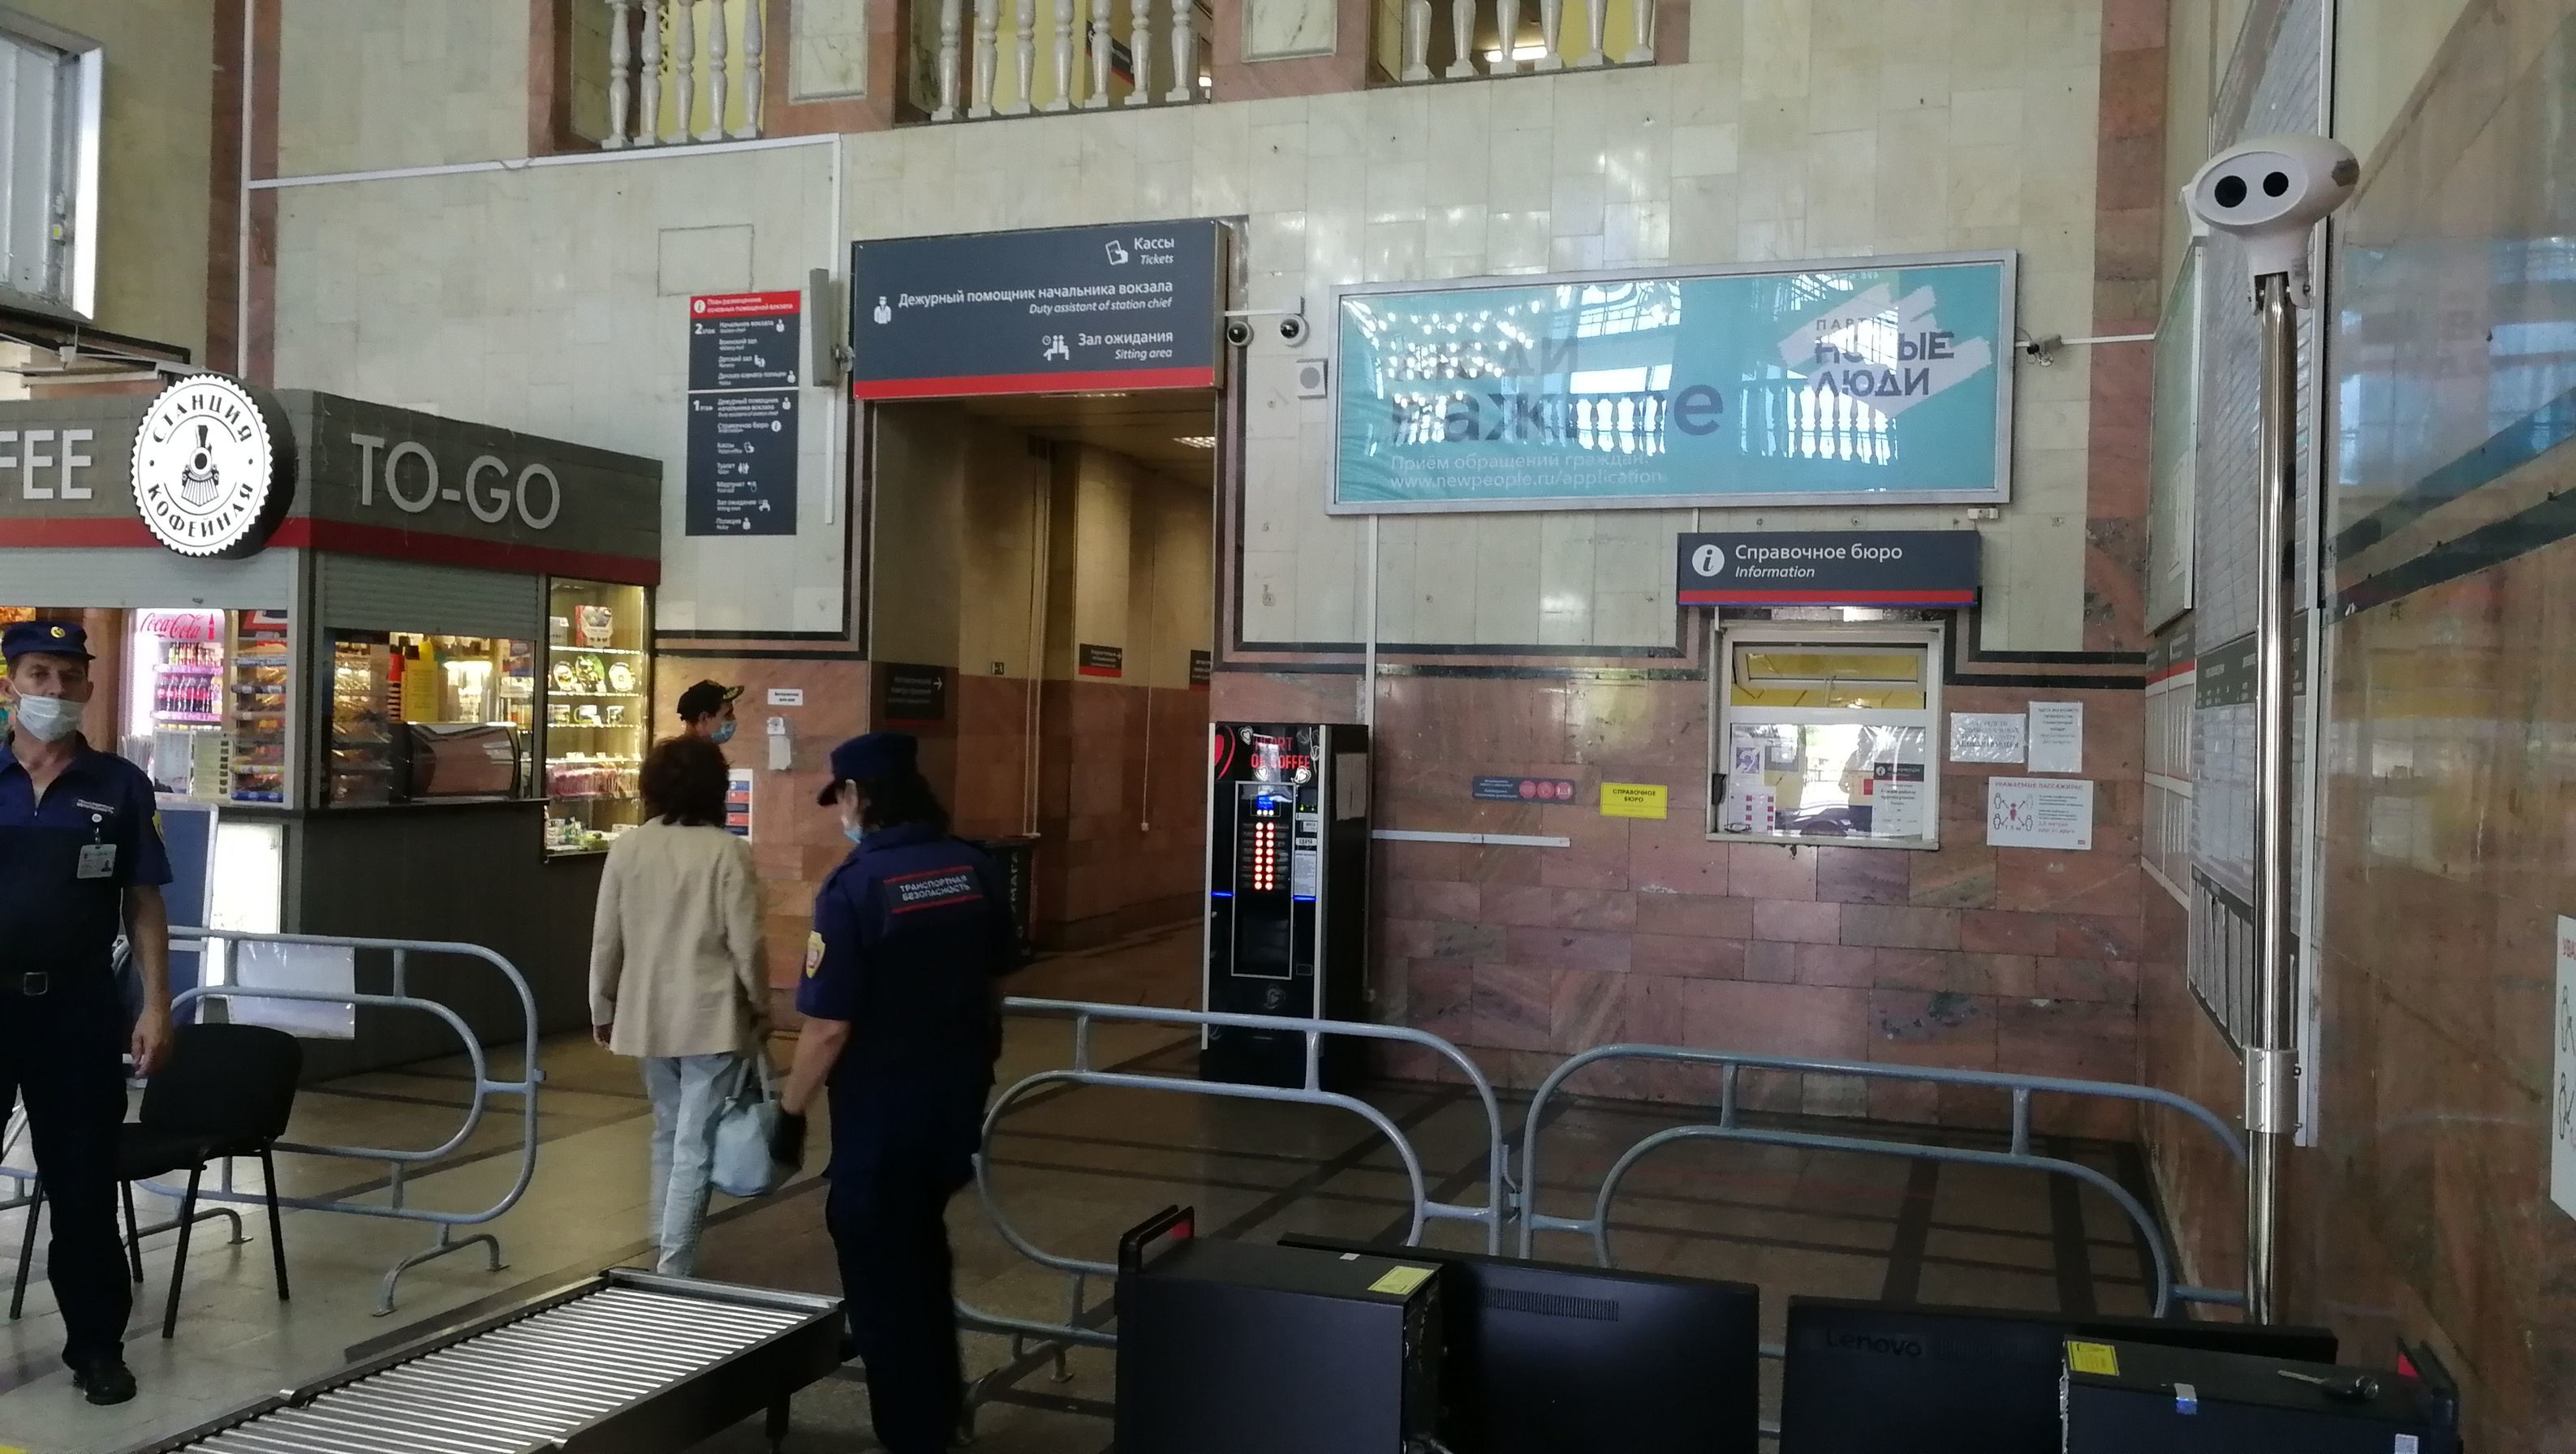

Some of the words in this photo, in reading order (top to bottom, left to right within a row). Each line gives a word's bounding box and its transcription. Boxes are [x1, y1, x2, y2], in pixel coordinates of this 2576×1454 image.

[1134, 237, 1175, 250] Кассы
[1140, 253, 1174, 265] Tickets
[898, 290, 964, 308] Дежурный
[967, 288, 1036, 304] помощник
[1038, 285, 1117, 299] начальника
[1119, 282, 1173, 294] вокзала
[1029, 303, 1053, 316] Duty
[1054, 302, 1097, 314] assistant
[1098, 299, 1111, 311] of
[1111, 299, 1146, 310] station
[1148, 297, 1173, 309] chief
[695, 323, 703, 334] 2
[1078, 333, 1102, 346] Зал
[1105, 332, 1173, 346] ожидания
[1815, 331, 1954, 364] НЫЕ
[1115, 348, 1148, 361] Sitting
[1148, 349, 1173, 359] area
[1816, 367, 1930, 398] ЛЮДИ
[693, 400, 700, 411] 1
[1392, 383, 1723, 443] аже
[153, 394, 252, 444] СТАНЦИЯ
[1391, 455, 1450, 473] Приём
[1454, 452, 1559, 471] обращений
[351, 432, 561, 529] TO-GO
[148, 483, 253, 538] КОФЕЙНАЯ
[1735, 544, 1846, 563] Справочное
[1851, 543, 1902, 562] бюро
[1735, 566, 1816, 579] Information
[140, 613, 203, 639] Coca-Cola
[1613, 788, 1656, 797] СПРАВОЧНОЕ
[1826, 1327, 1922, 1357] Lenovo
